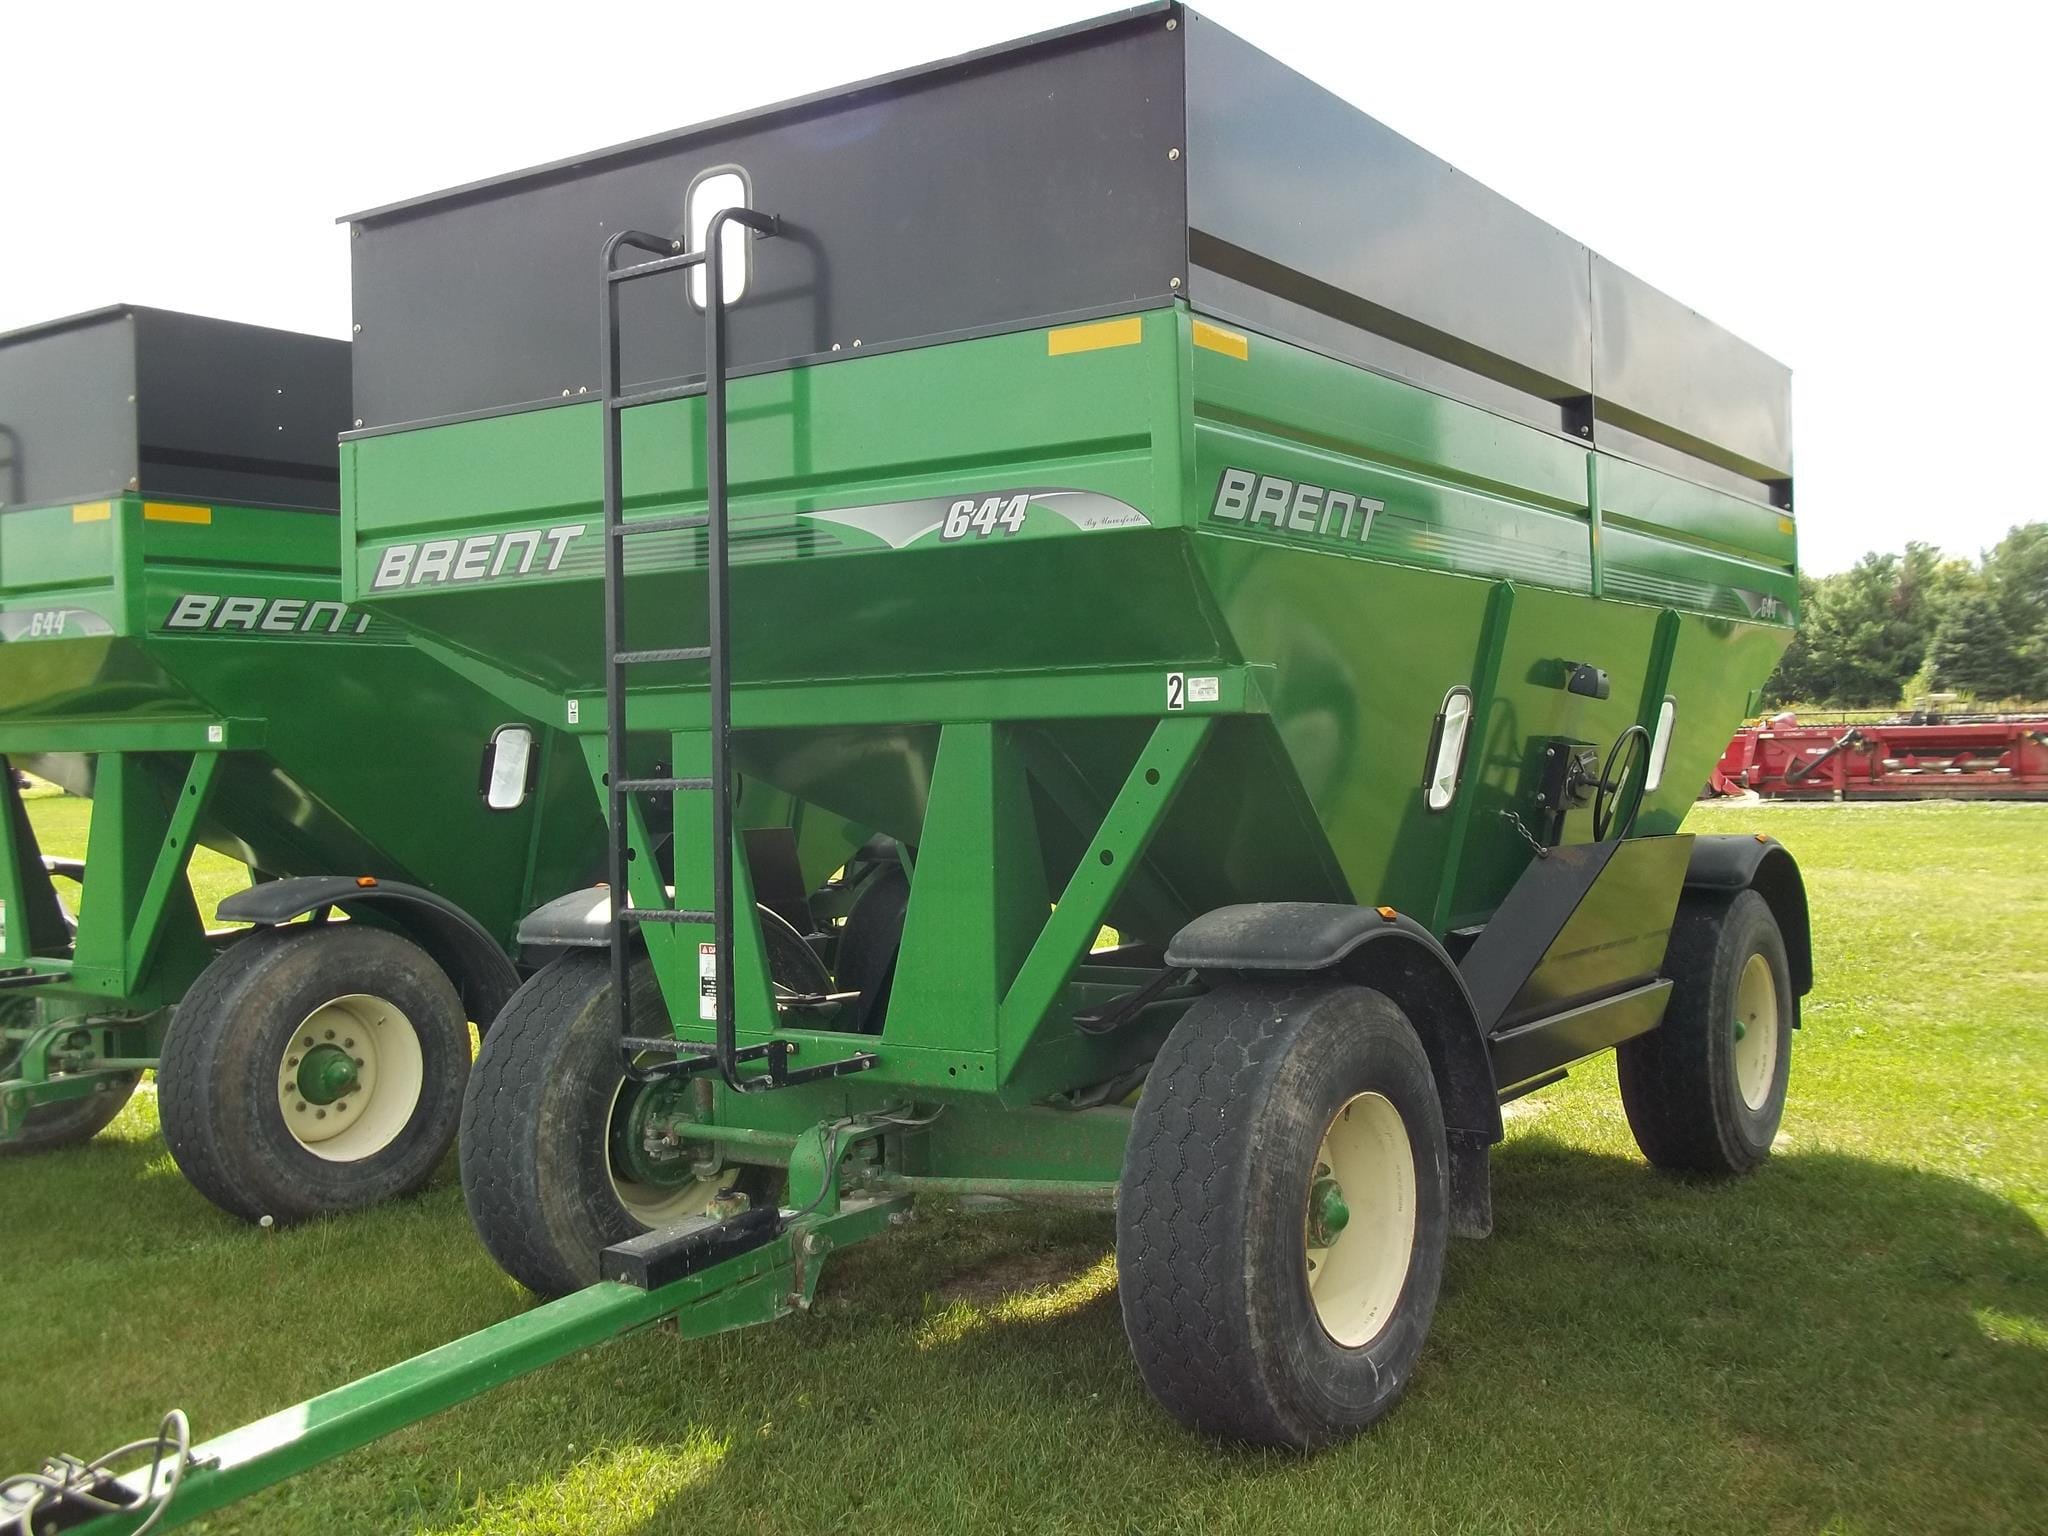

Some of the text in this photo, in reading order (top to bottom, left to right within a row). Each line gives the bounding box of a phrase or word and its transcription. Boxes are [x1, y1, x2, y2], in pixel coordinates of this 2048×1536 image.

[943, 494, 1030, 540] 644
[1210, 467, 1386, 543] BRENT
[370, 524, 588, 591] BRENT
[30, 610, 66, 637] 644
[1168, 675, 1183, 709] 2
